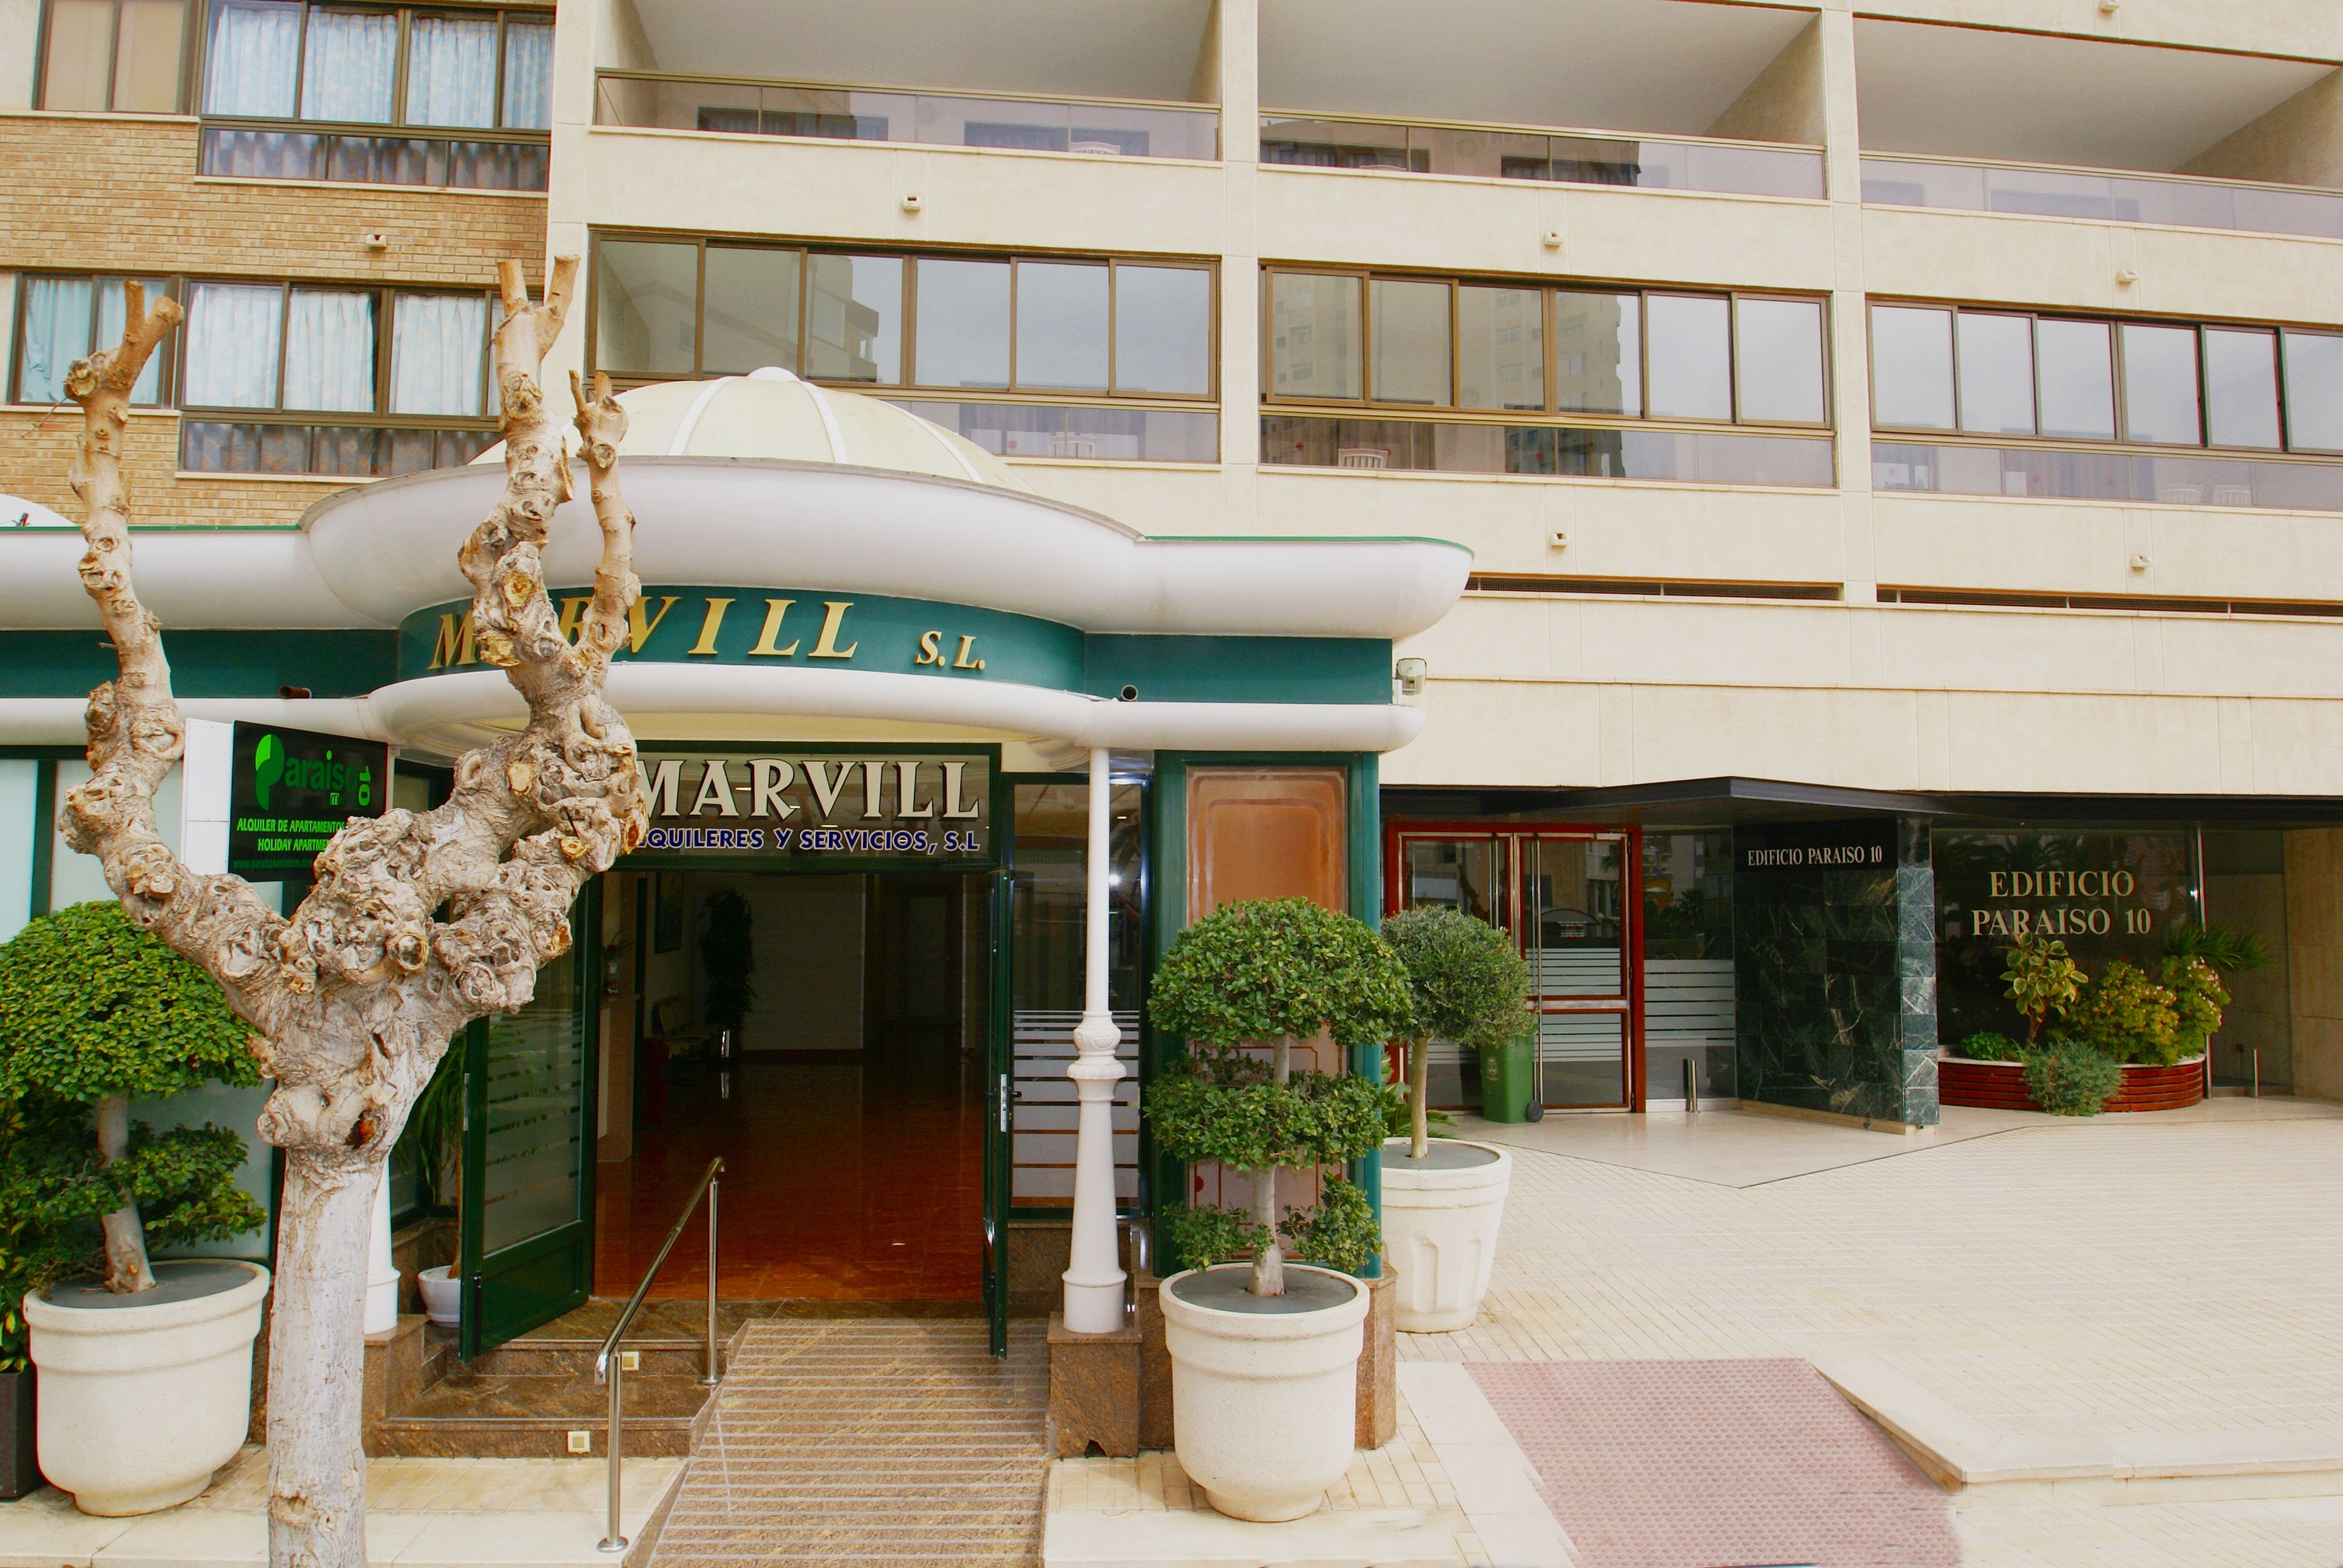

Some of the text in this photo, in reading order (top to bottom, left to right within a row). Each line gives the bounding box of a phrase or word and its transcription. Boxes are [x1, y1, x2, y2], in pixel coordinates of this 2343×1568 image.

[255, 733, 358, 811] Paraiso
[237, 818, 276, 832] ALQUILER
[278, 819, 289, 832] DE
[258, 838, 330, 851] HOLIDAY APARTME
[638, 827, 765, 850] QUILERES
[773, 827, 793, 850] Y
[944, 830, 980, 851] S.L
[1748, 845, 1883, 866] EDIFICIO PARAISO 10
[1989, 871, 2135, 897] EDIFICIO
[1971, 908, 2152, 935] PARAISO 10
